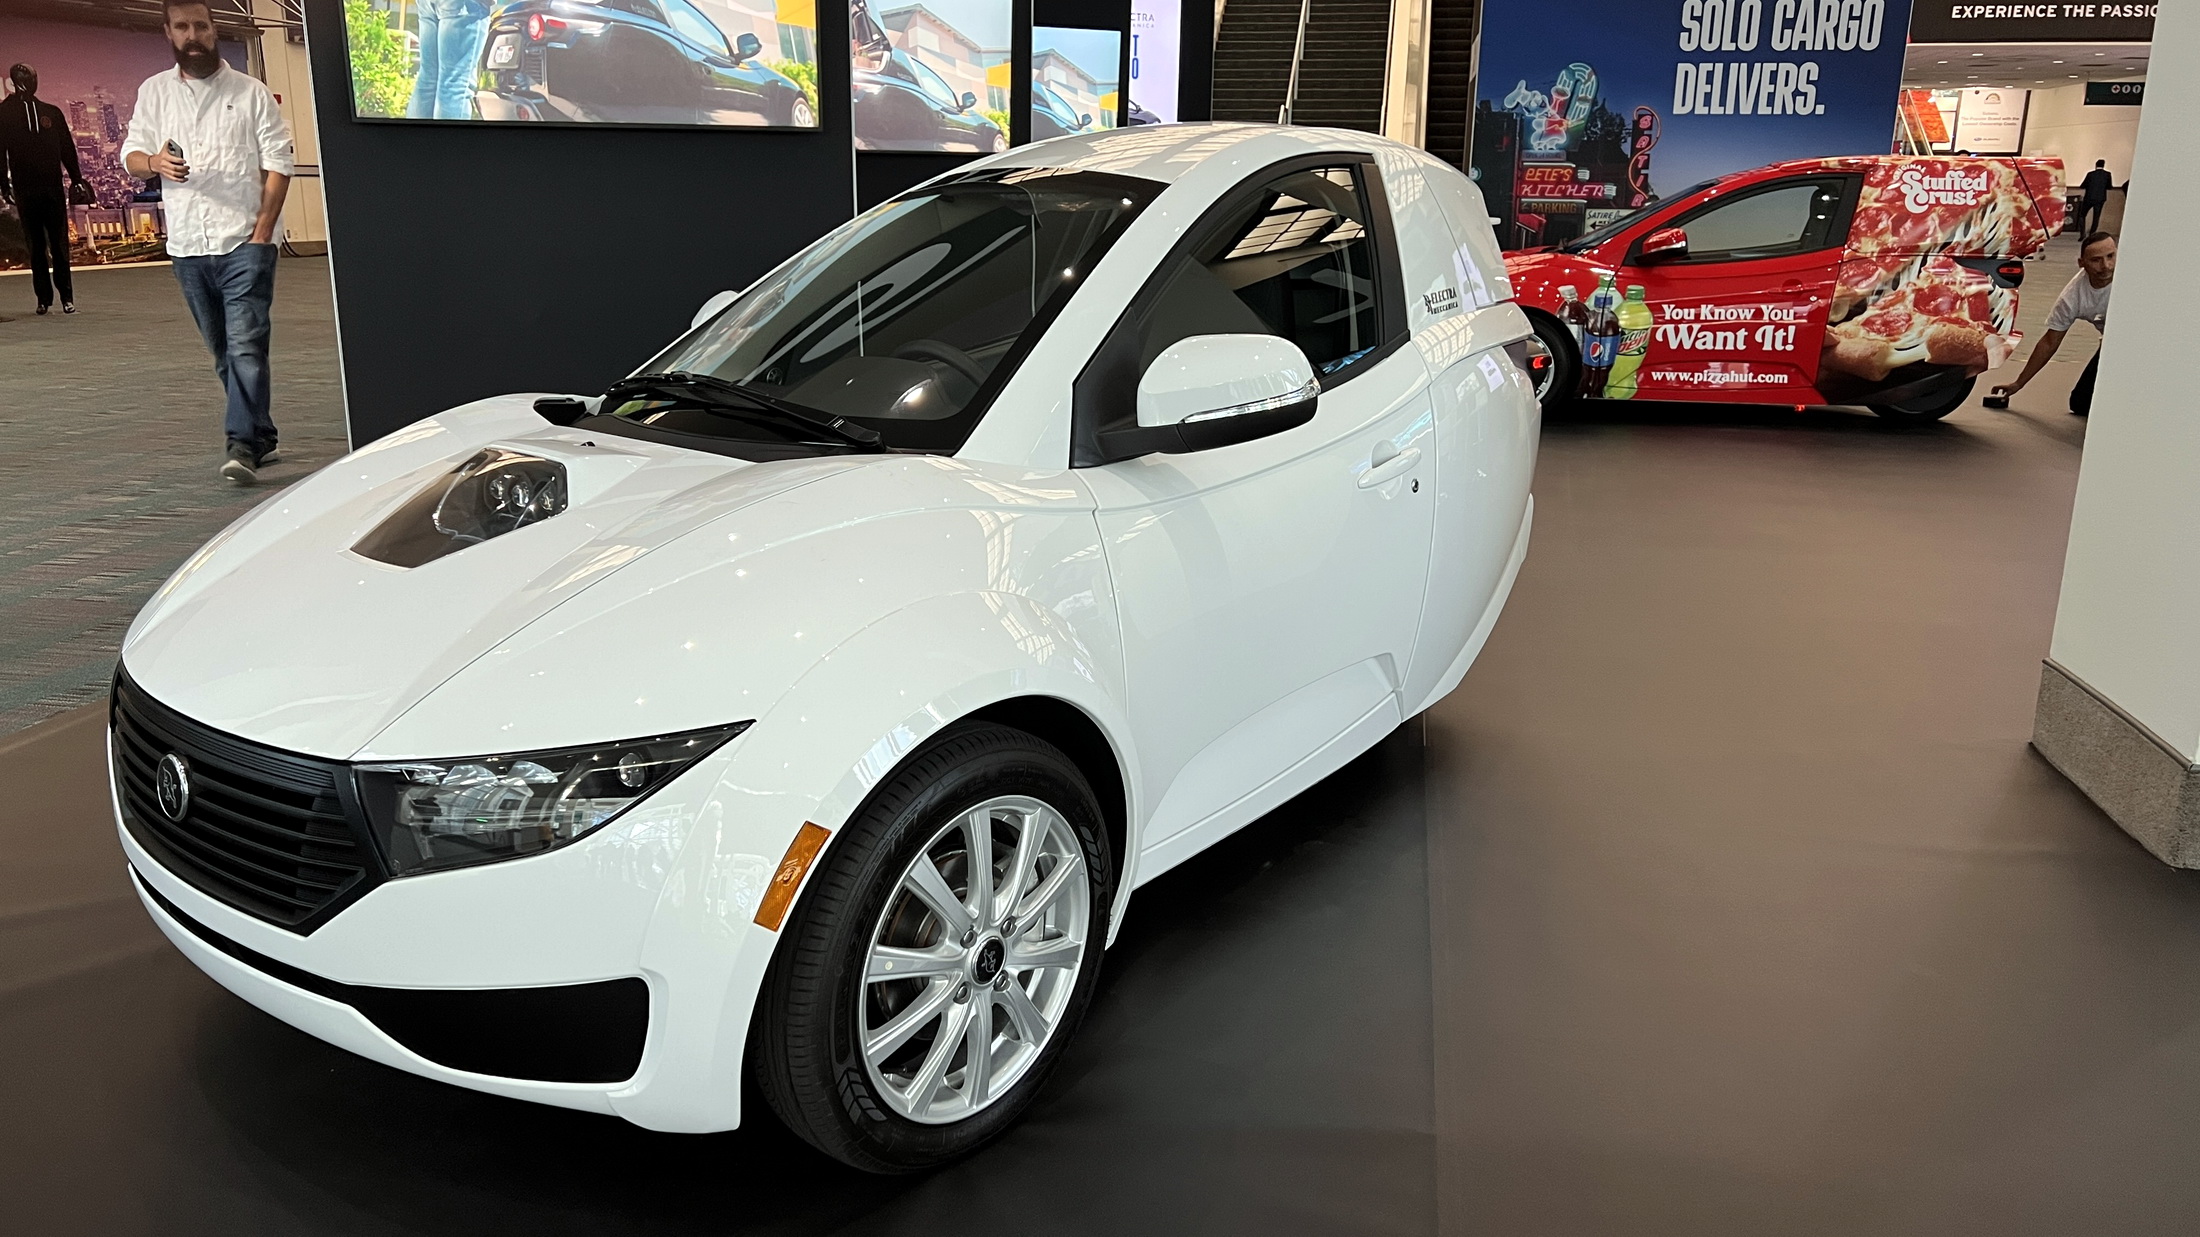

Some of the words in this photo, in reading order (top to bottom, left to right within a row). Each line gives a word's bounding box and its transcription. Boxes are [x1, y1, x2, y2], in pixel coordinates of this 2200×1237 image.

[1951, 5, 2058, 18] EXPERIENCE
[2063, 5, 2096, 17] THE
[1679, 0, 1762, 51] SOLO
[1771, 0, 1885, 51] CARGO
[1673, 62, 1825, 115] DELIVERS.
[1525, 168, 1573, 181] PETE'S
[1900, 170, 1988, 196] Stuffed
[1521, 184, 1605, 197] KITCHEN
[1531, 203, 1577, 213] PARKING
[1904, 189, 1978, 214] Crust
[1587, 210, 1614, 219] SATIRE
[1431, 286, 1457, 304] ELECTRA
[1662, 304, 1696, 320] You
[1700, 304, 1755, 320] Know
[1761, 304, 1795, 321] You
[1655, 323, 1748, 350] Want
[1755, 325, 1796, 351] It!
[1651, 371, 1788, 384] www.pizzahut.com
